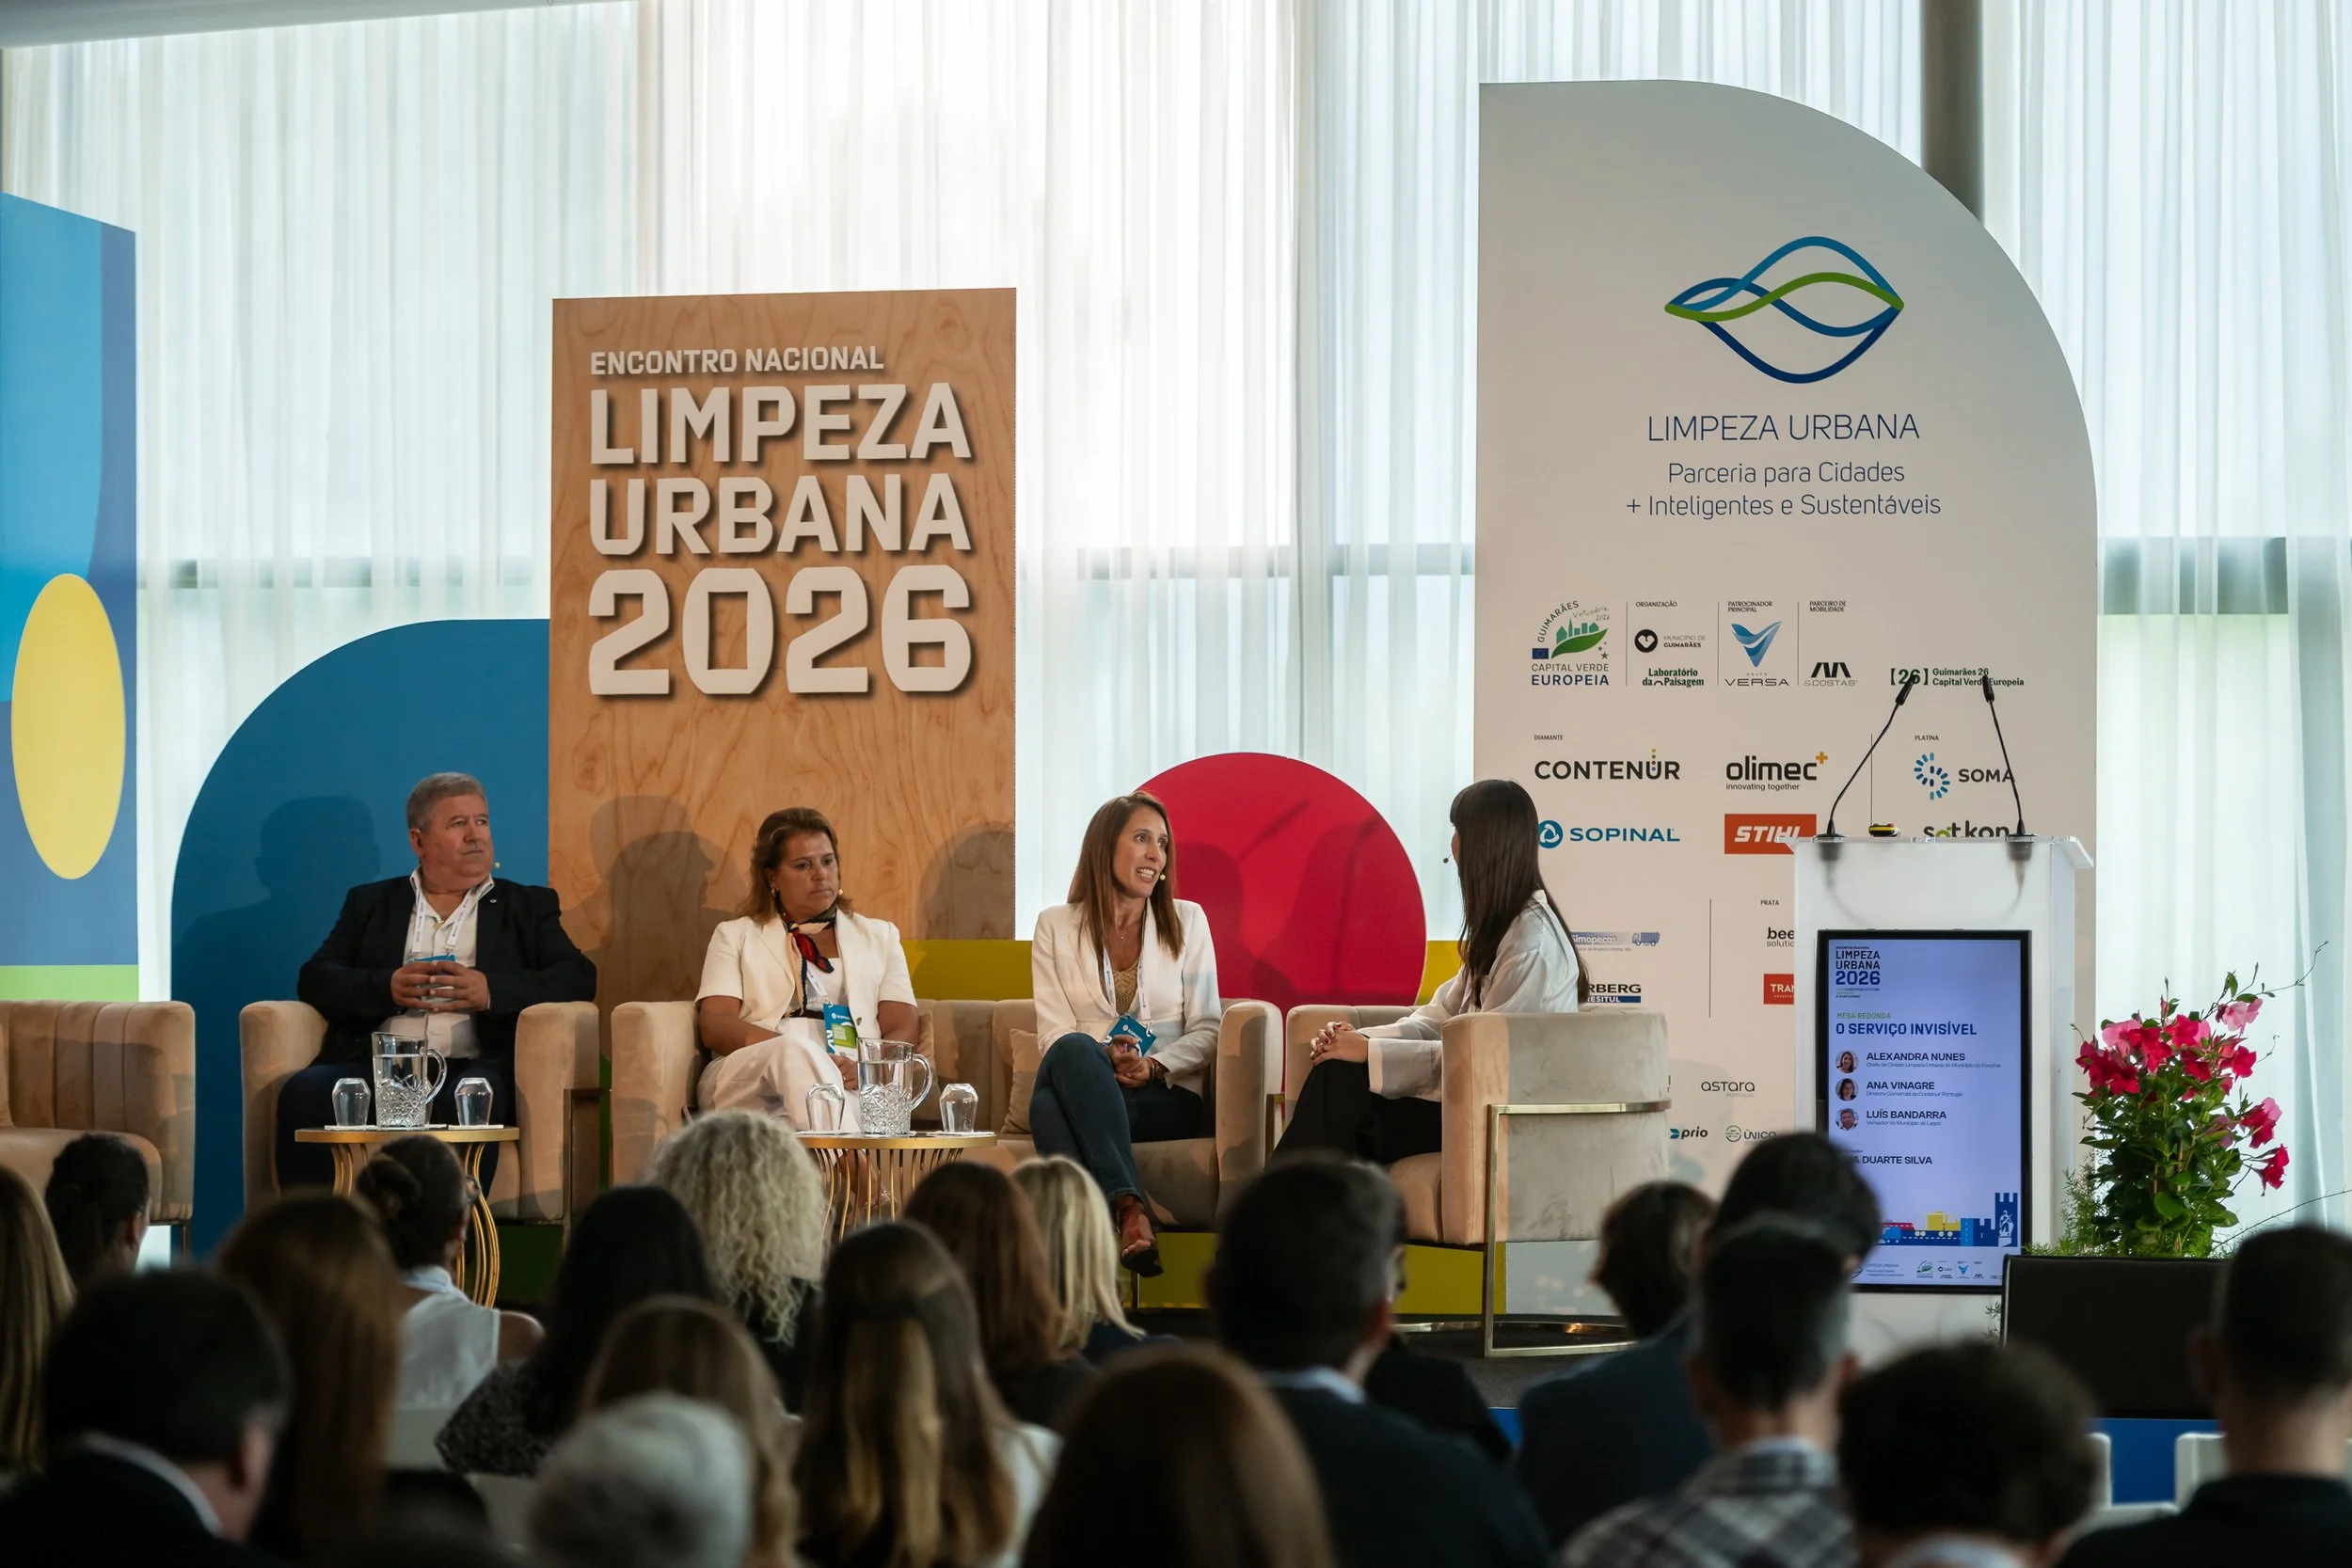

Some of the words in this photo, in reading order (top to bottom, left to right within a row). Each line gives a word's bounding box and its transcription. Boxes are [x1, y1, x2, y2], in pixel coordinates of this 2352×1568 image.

[591, 349, 738, 375] ENCONTRO
[745, 345, 884, 372] NACIONAL
[591, 382, 972, 466] LIMPEZA
[1648, 415, 1779, 441] LIMPEZA
[1789, 413, 1920, 440] URBANA
[1668, 463, 1756, 483] Parceria
[1764, 466, 1811, 487] para
[1818, 461, 1905, 483] Cidades
[1648, 494, 1774, 520] Inteligentes
[1781, 499, 1794, 515] e
[1801, 493, 1941, 515] Sustentáveis
[590, 473, 972, 555] URBANA
[1537, 600, 1580, 643] GUIMARÃES
[588, 564, 972, 695] 2026
[1532, 663, 1572, 672] CAPITAL
[1576, 663, 1609, 672] VERDE
[1648, 668, 1698, 676] Laboratório
[1932, 668, 1977, 676] Guimarães
[1978, 668, 1989, 676] 26
[1532, 674, 1609, 686] EUROPEIA
[1663, 677, 1704, 688] Paisagem
[1724, 678, 1789, 687] VERSA
[1932, 677, 1963, 687] Capital
[1963, 677, 1984, 687] Verd
[1534, 760, 1680, 780] CONTENUR
[1725, 755, 1818, 781] olimec
[1958, 768, 2015, 783] SOMA
[1725, 783, 1766, 791] innovating
[1768, 783, 1800, 791] together
[1569, 828, 1680, 842] SOPINAL
[1836, 950, 1880, 959] LIMPEZA
[1836, 960, 1880, 970] URBANA
[1836, 971, 1881, 985] 2026
[1836, 1022, 1845, 1035] O
[1848, 1022, 1907, 1037] SERVIÇO
[1911, 1021, 1978, 1035] INVISÍVEL
[1867, 1053, 1929, 1061] ALEXANDRA
[1931, 1053, 1965, 1061] NUNES
[1701, 1082, 1756, 1092] astara
[1867, 1081, 1888, 1089] ANA
[1890, 1081, 1935, 1089] VINAGRE
[1867, 1109, 1888, 1118] LUÍS
[1681, 1126, 1708, 1140] prio
[1863, 1156, 1902, 1164] DUARTE
[1904, 1156, 1932, 1164] SILVA
